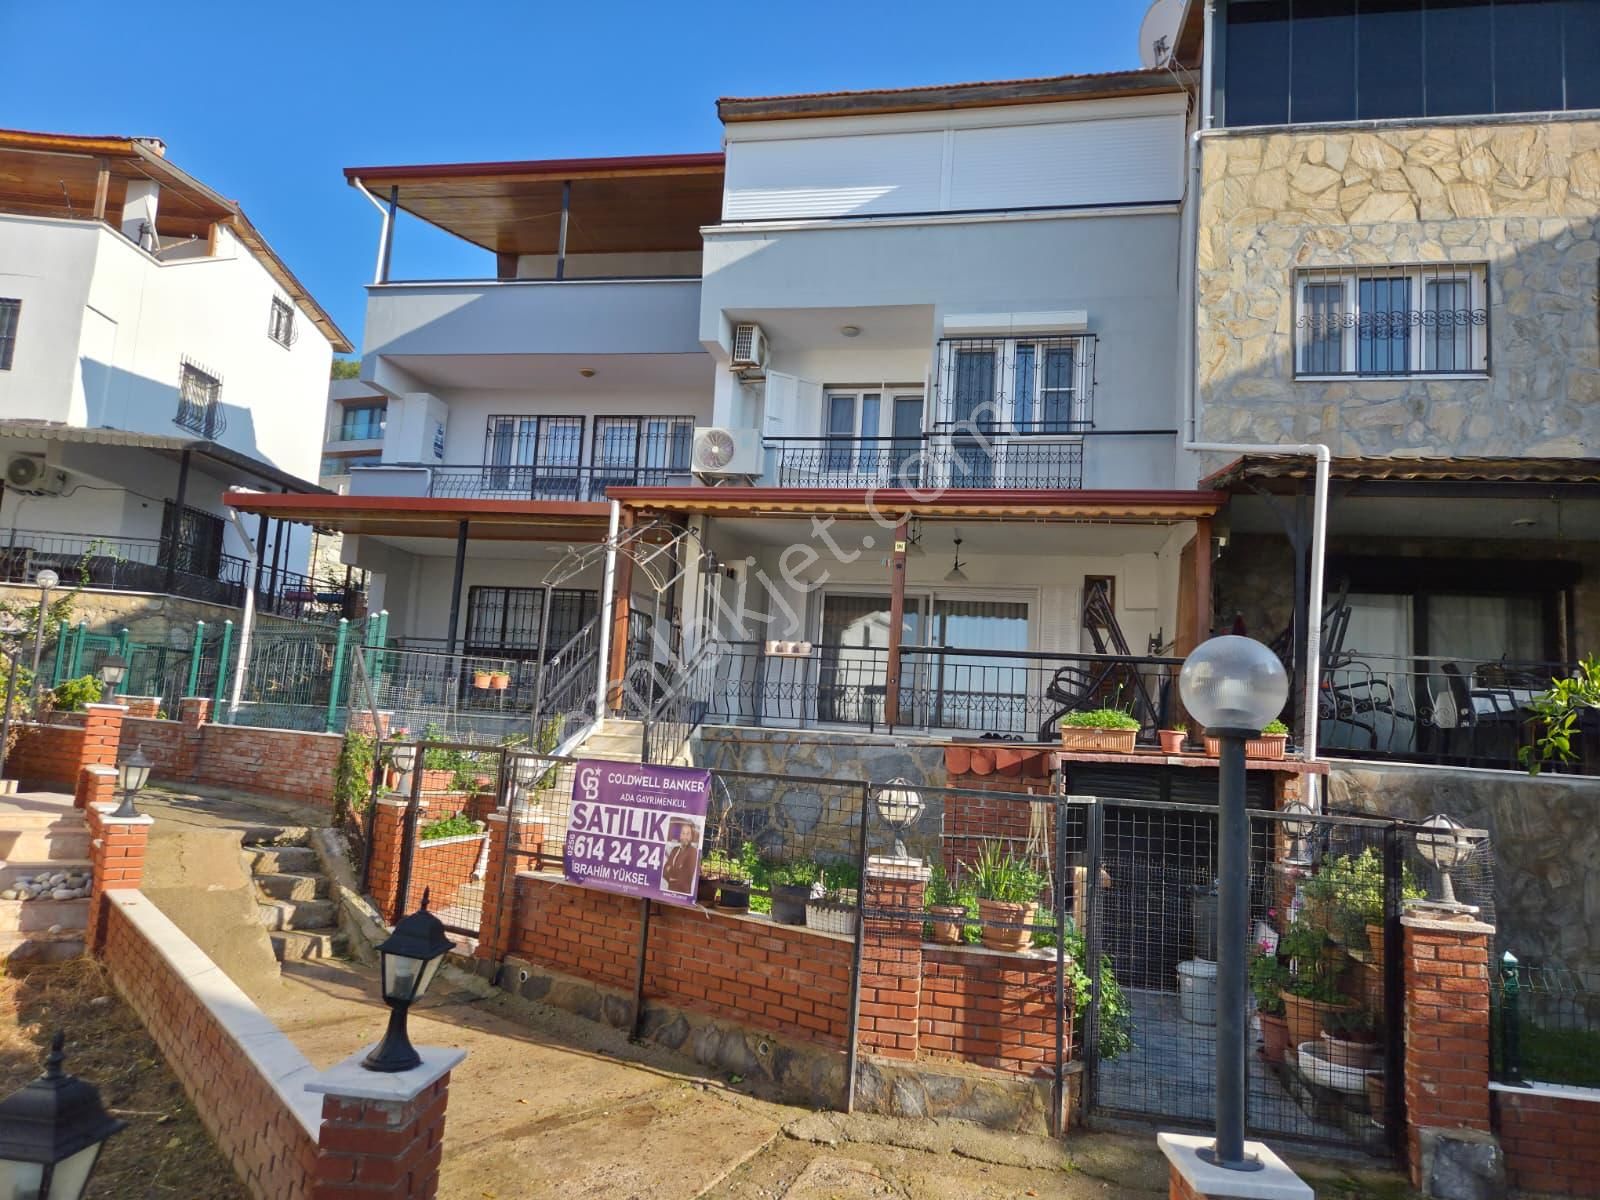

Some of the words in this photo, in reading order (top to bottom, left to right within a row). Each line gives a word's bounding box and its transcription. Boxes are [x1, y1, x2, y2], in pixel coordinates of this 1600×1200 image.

[608, 773, 660, 789] COLDWELL
[663, 778, 705, 793] BANKER
[620, 793, 635, 803] ADA
[572, 803, 668, 842] SATILIK
[574, 835, 605, 861] 614
[608, 840, 632, 866] 24
[636, 845, 661, 870] 24
[572, 860, 611, 879] İBRAHİM
[612, 868, 650, 887] YÜKSEL
